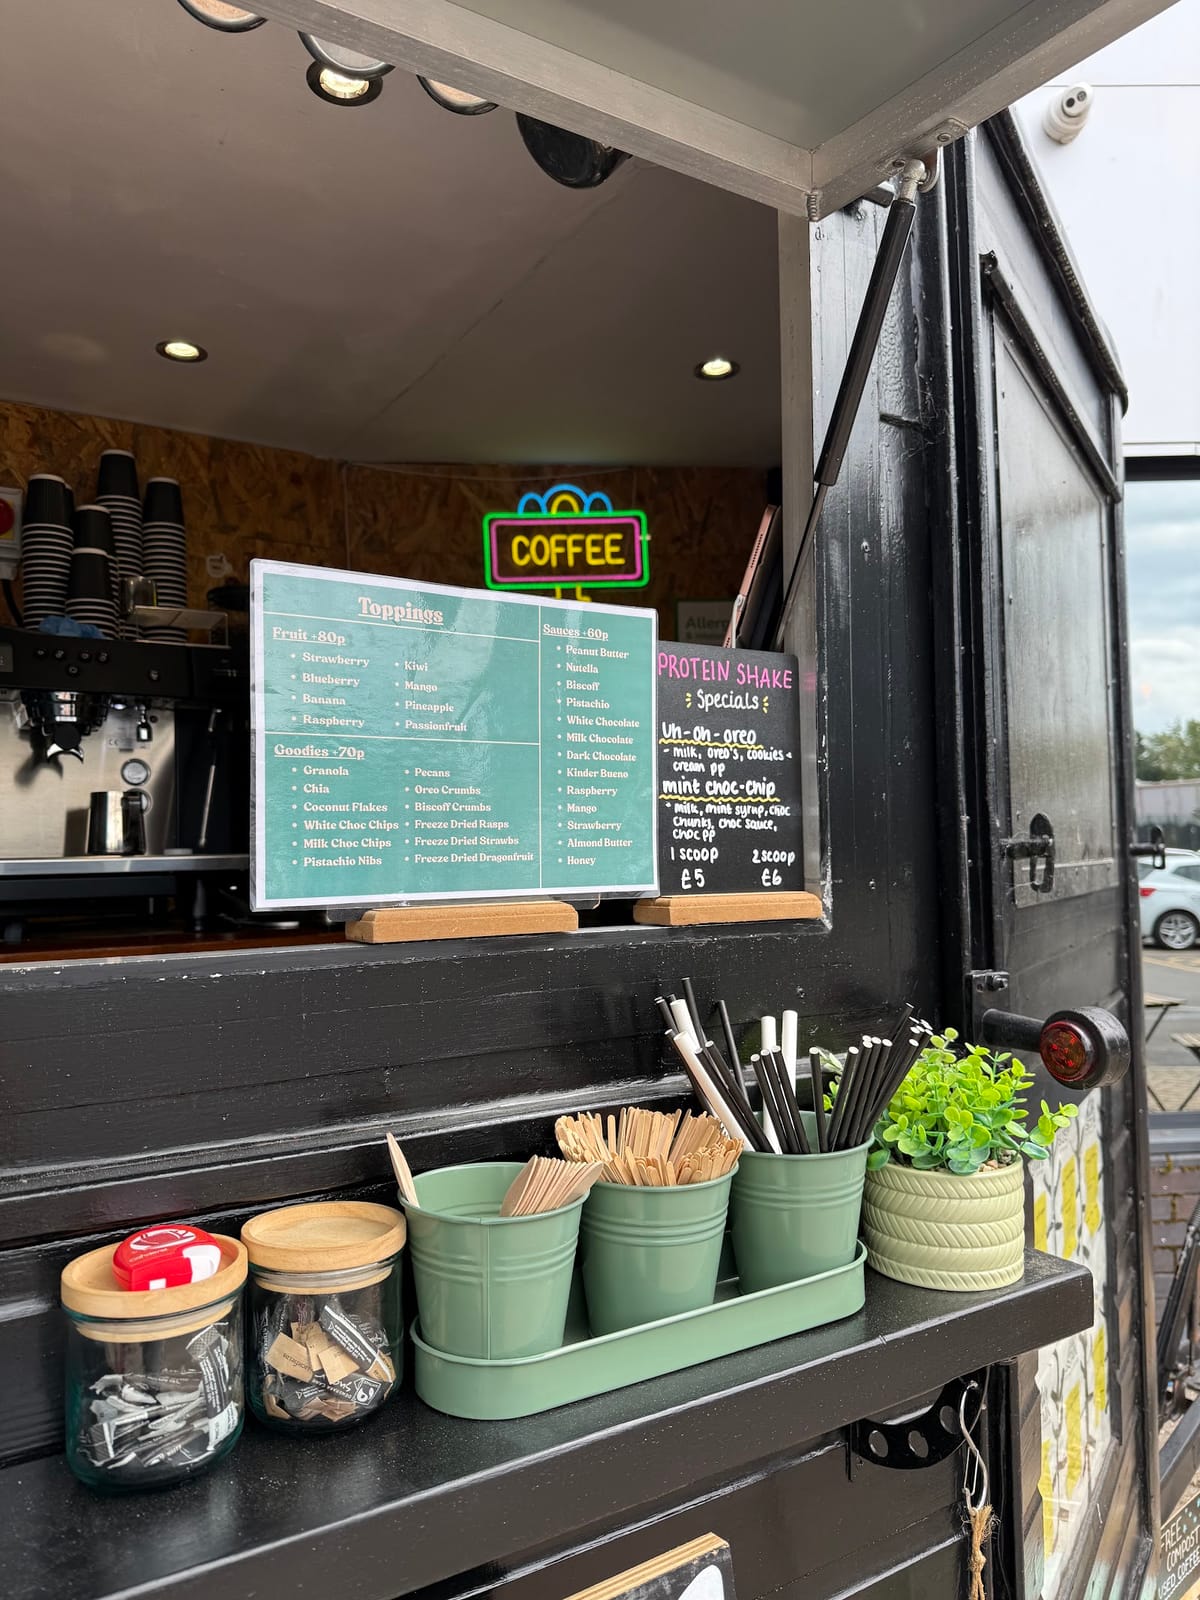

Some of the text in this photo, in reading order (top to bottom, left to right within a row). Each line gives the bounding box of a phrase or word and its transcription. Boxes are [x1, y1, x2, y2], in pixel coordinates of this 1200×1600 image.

[511, 533, 625, 568] COFFEE
[358, 597, 444, 625] Toppings
[272, 627, 345, 645] Fruit +80p
[543, 624, 609, 641] Sauces +60p
[566, 645, 629, 659] Peanut Butter
[302, 652, 369, 667] Strawberry
[404, 661, 428, 671] Kiwi
[566, 662, 599, 674] Nutella
[658, 653, 792, 689] PROTEIN SHAKE
[302, 673, 360, 687] Blueberry
[566, 680, 600, 691] Biscoff
[405, 681, 438, 693] Mango
[303, 694, 346, 705] Banana
[566, 697, 610, 709] Pistachio
[697, 688, 759, 712] Specials
[405, 701, 455, 713] Pineapple
[303, 714, 364, 728] Raspberry
[405, 720, 467, 732] Passionfruit
[567, 715, 640, 728] White Chocolate
[566, 732, 634, 744] Milk Chocolate
[274, 744, 365, 760] Goodies +70p
[566, 750, 637, 762] Dark Chocolate
[747, 747, 784, 761] cookies
[303, 766, 349, 776] Granola
[414, 768, 450, 778] Pecans
[566, 767, 628, 778] Kinder Bueno
[673, 761, 725, 777] cream pp
[303, 783, 330, 794] Chia
[414, 785, 481, 795] Oreo Crumbs
[567, 785, 618, 797] Raspberry
[663, 776, 700, 794] mint
[303, 802, 388, 812] Coconut Flakes
[414, 802, 491, 812] Biscoff Crumbs
[567, 803, 597, 814] Mango
[705, 802, 732, 815] mint
[769, 805, 791, 816] choc
[304, 820, 399, 832] White Choc Chips
[414, 820, 509, 830] Freeze Dried Rasps
[567, 820, 622, 831] Strawberry
[719, 818, 742, 829] choc
[673, 829, 700, 840] choc
[304, 838, 392, 850] Milk Choc Chips
[414, 836, 519, 846] Freeze Dried Strawbs
[567, 838, 633, 848] Almond Butter
[414, 853, 534, 864] Freeze Dried Dragonfruit
[567, 856, 596, 866] Honey
[679, 847, 719, 863] scoop
[761, 850, 795, 866] scoop
[303, 856, 382, 867] Pistachio Nibs
[681, 868, 705, 889] £5
[761, 868, 782, 887] £6
